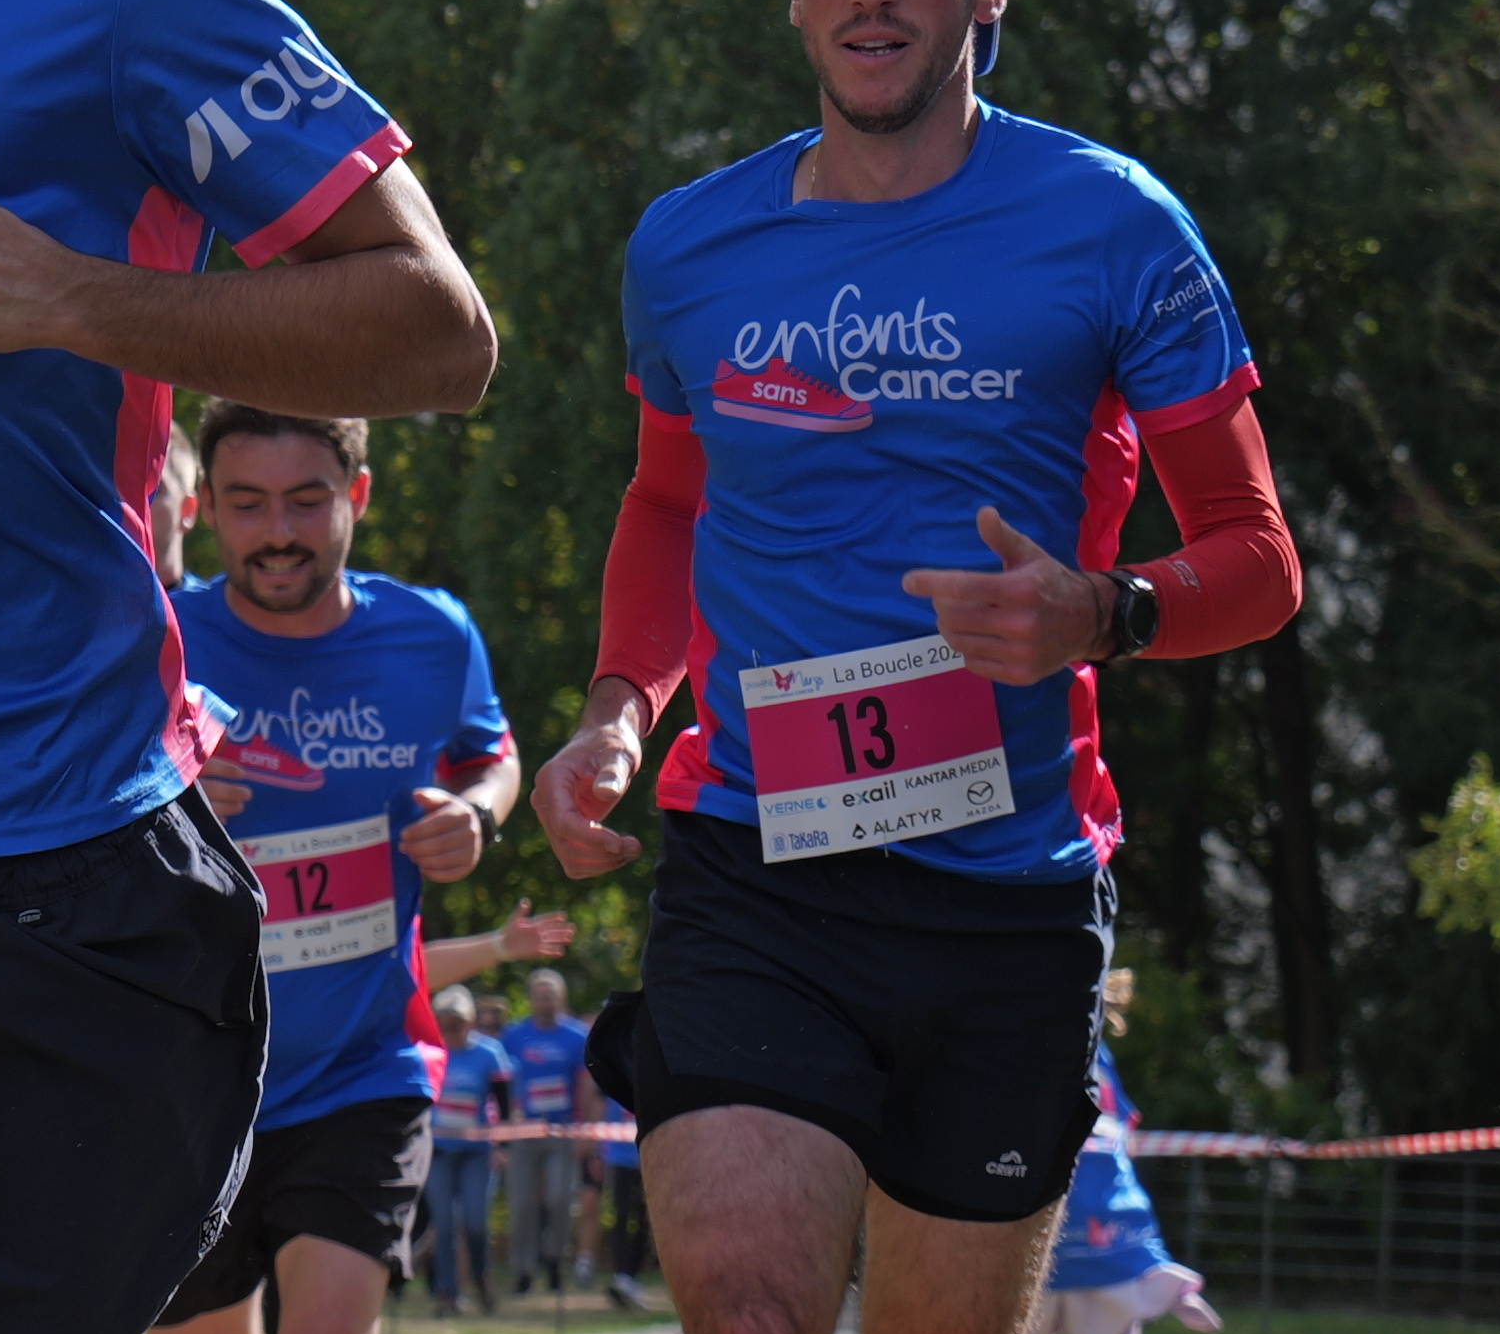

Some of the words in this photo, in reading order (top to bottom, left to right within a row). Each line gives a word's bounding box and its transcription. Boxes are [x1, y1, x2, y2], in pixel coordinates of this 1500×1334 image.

[729, 284, 962, 373] enfants
[751, 380, 808, 406] sans
[839, 362, 1022, 402] Cancer
[833, 667, 856, 683] La
[860, 652, 923, 678] Boucle
[927, 645, 962, 665] 202
[228, 686, 386, 747] enfants
[827, 696, 896, 775] 13
[240, 750, 281, 770] sans
[302, 741, 419, 768] Cancer
[904, 768, 959, 789] KANTAR
[959, 756, 1001, 778] MEDIA
[764, 798, 815, 816] VERNE
[842, 780, 897, 808] exail
[873, 808, 943, 835] ALATYR
[966, 804, 1002, 818] MAZDA
[788, 830, 830, 851] TaKaRa
[285, 862, 333, 916] 12
